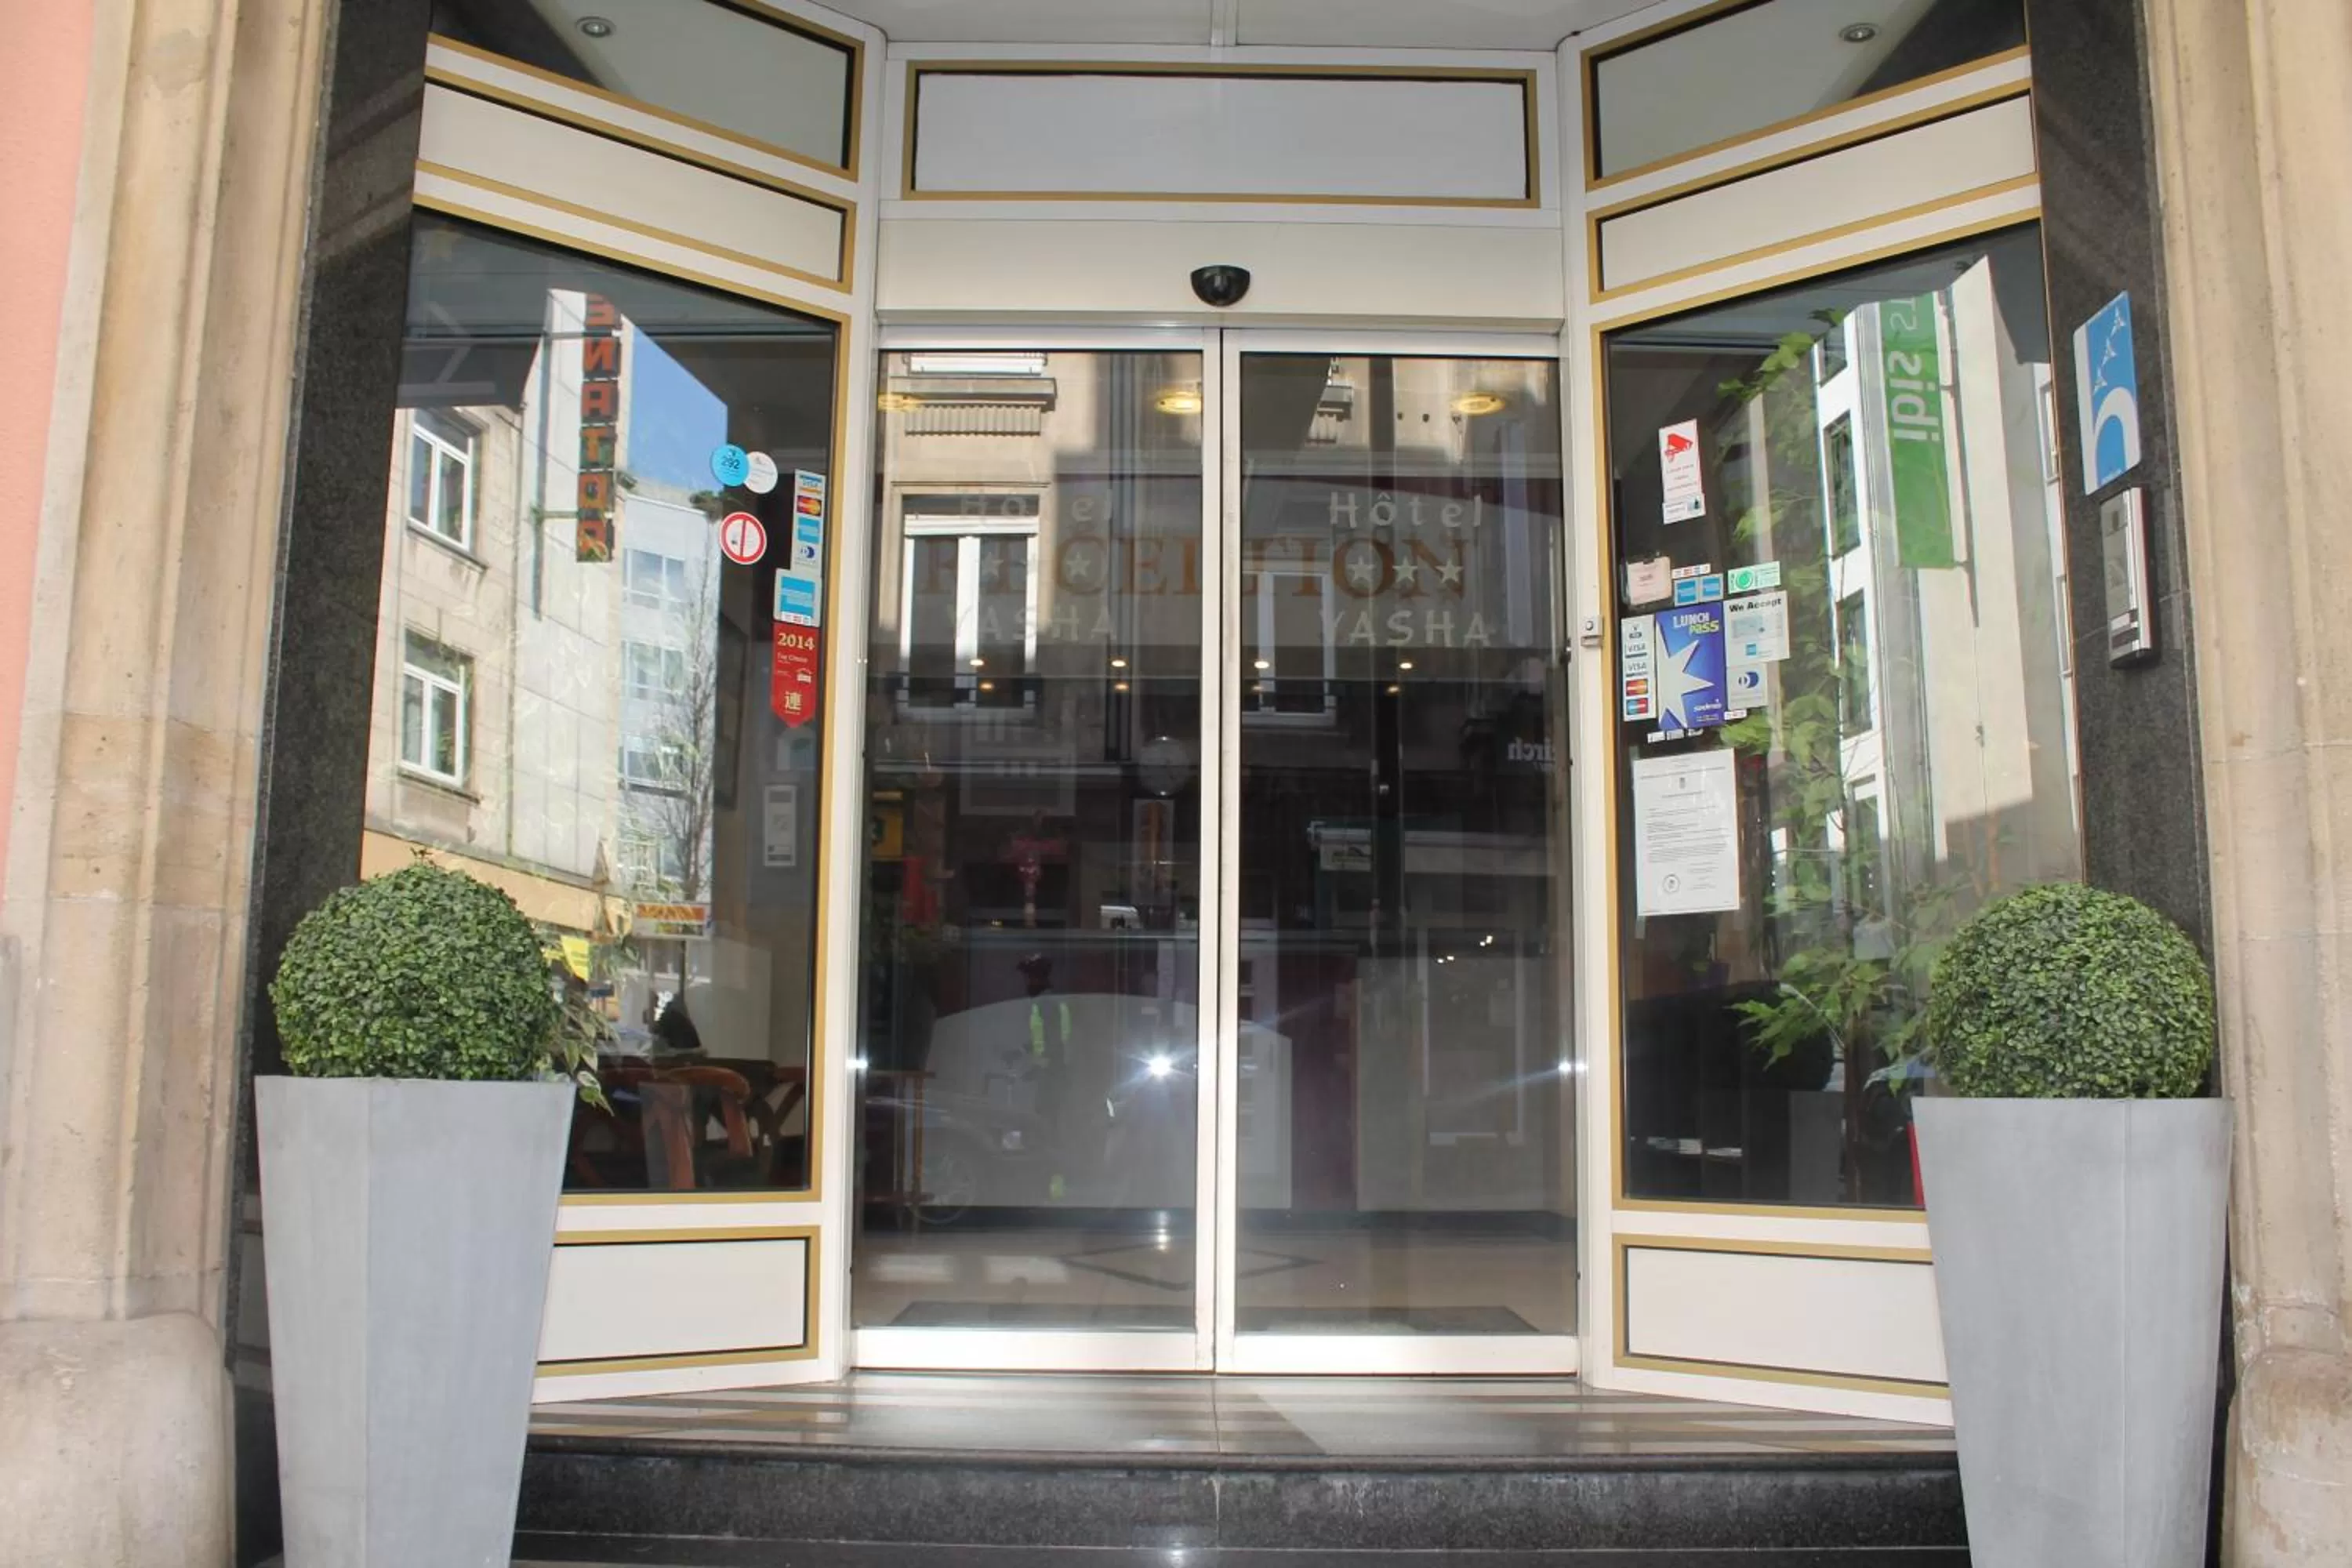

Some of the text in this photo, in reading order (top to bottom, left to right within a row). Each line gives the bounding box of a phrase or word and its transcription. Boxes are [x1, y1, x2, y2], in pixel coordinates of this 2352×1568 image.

[1330, 492, 1483, 528] Hôtel
[1729, 604, 1744, 613] We
[1320, 609, 1490, 647] YASHA
[777, 633, 815, 650] 2014
